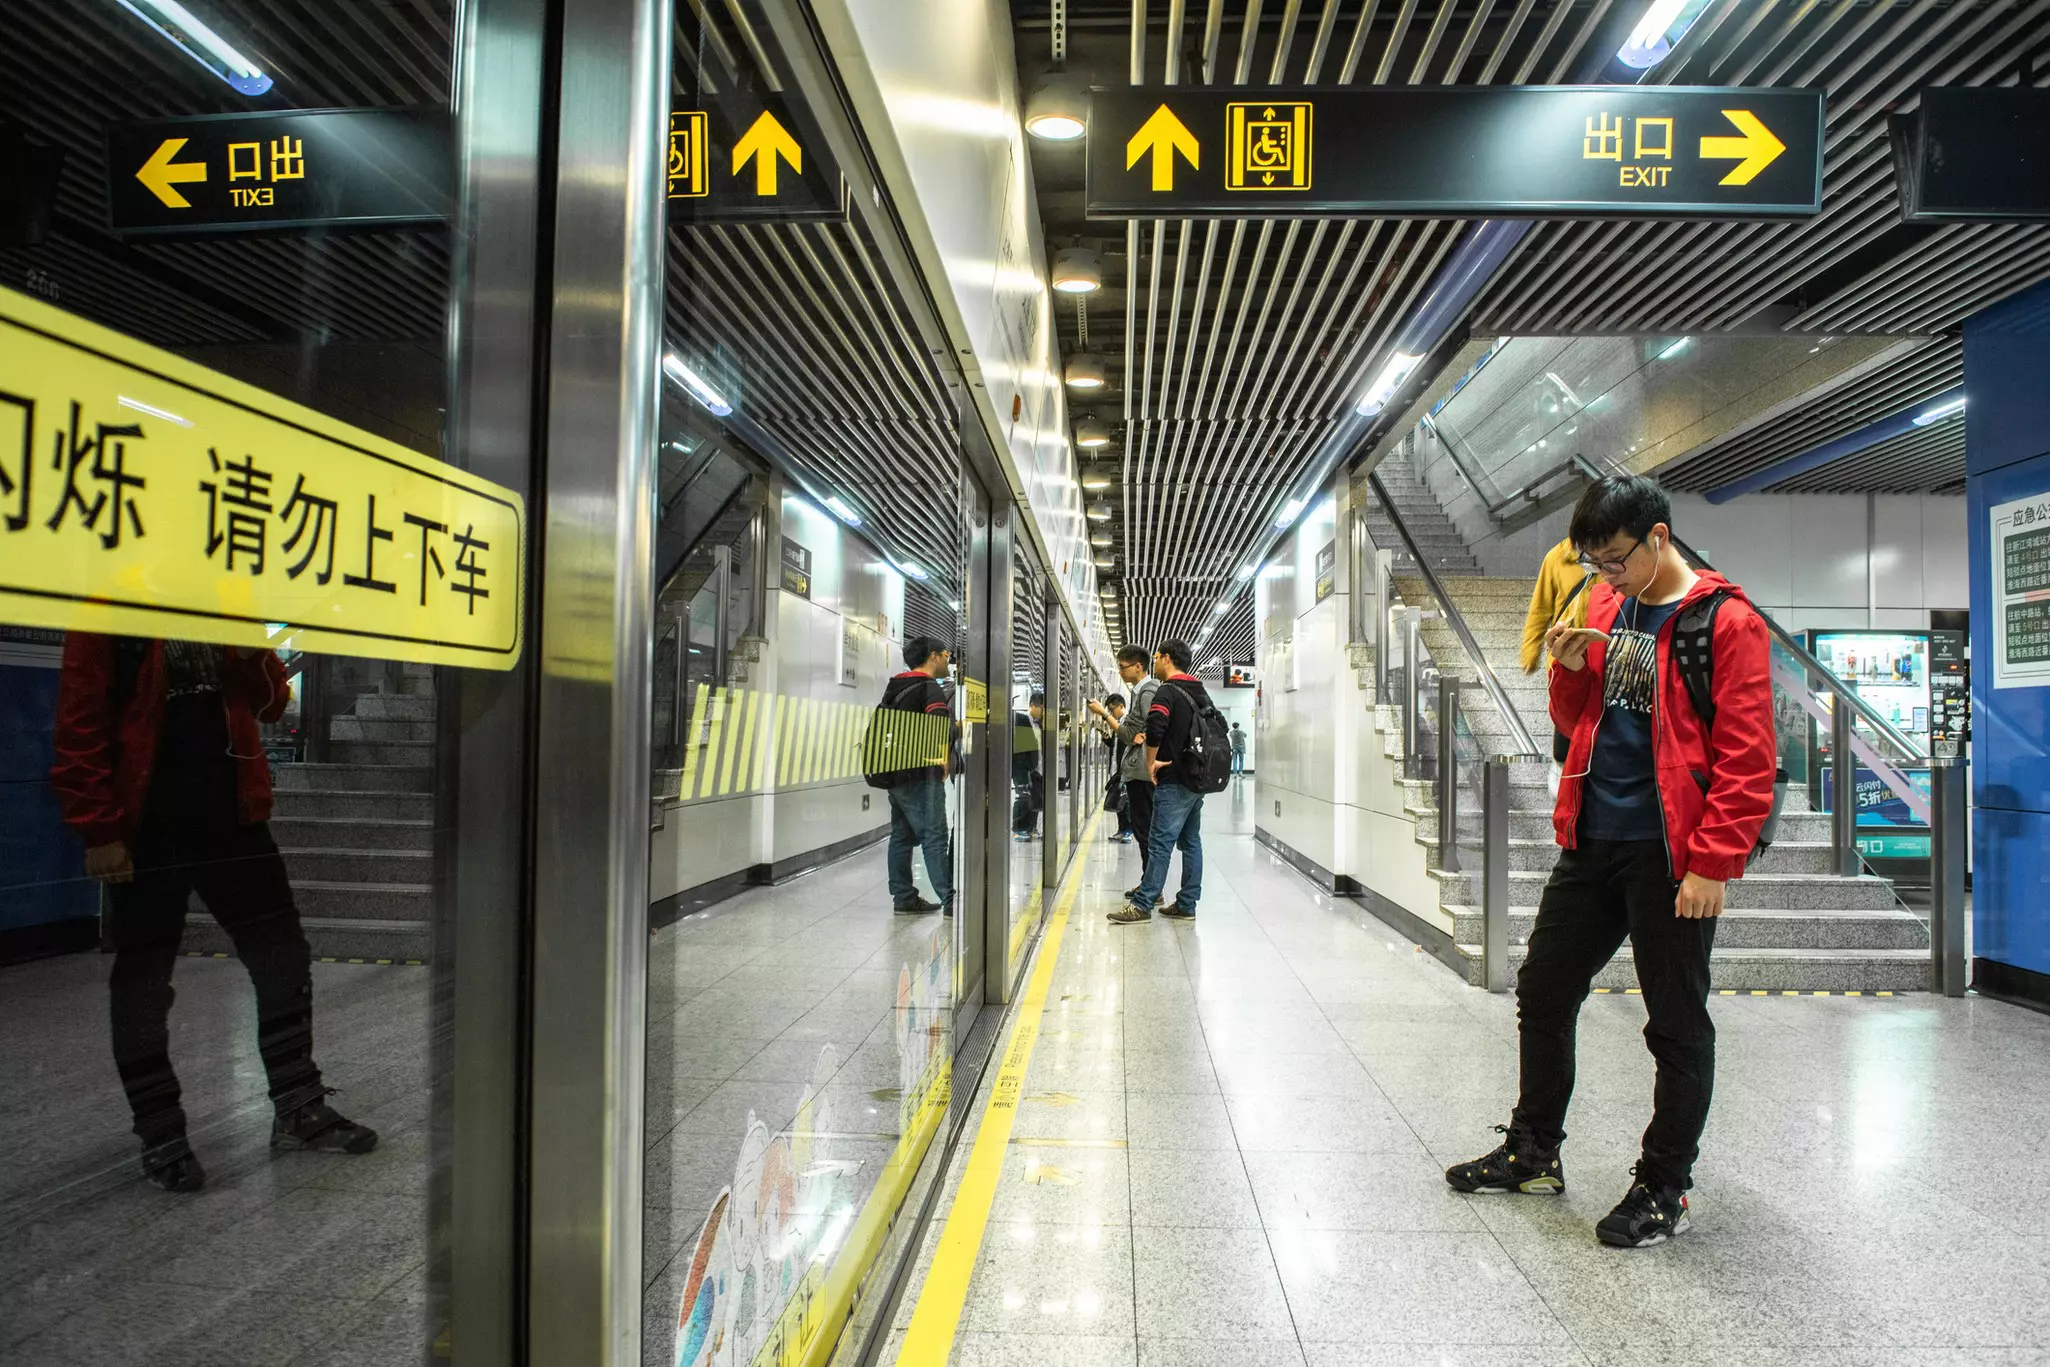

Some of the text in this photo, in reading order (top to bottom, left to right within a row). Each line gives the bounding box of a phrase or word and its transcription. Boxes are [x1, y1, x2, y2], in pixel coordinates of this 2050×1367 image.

[1582, 111, 1674, 162] 出口
[1619, 166, 1673, 187] EXIT
[198, 445, 491, 616] 请勿上下车
